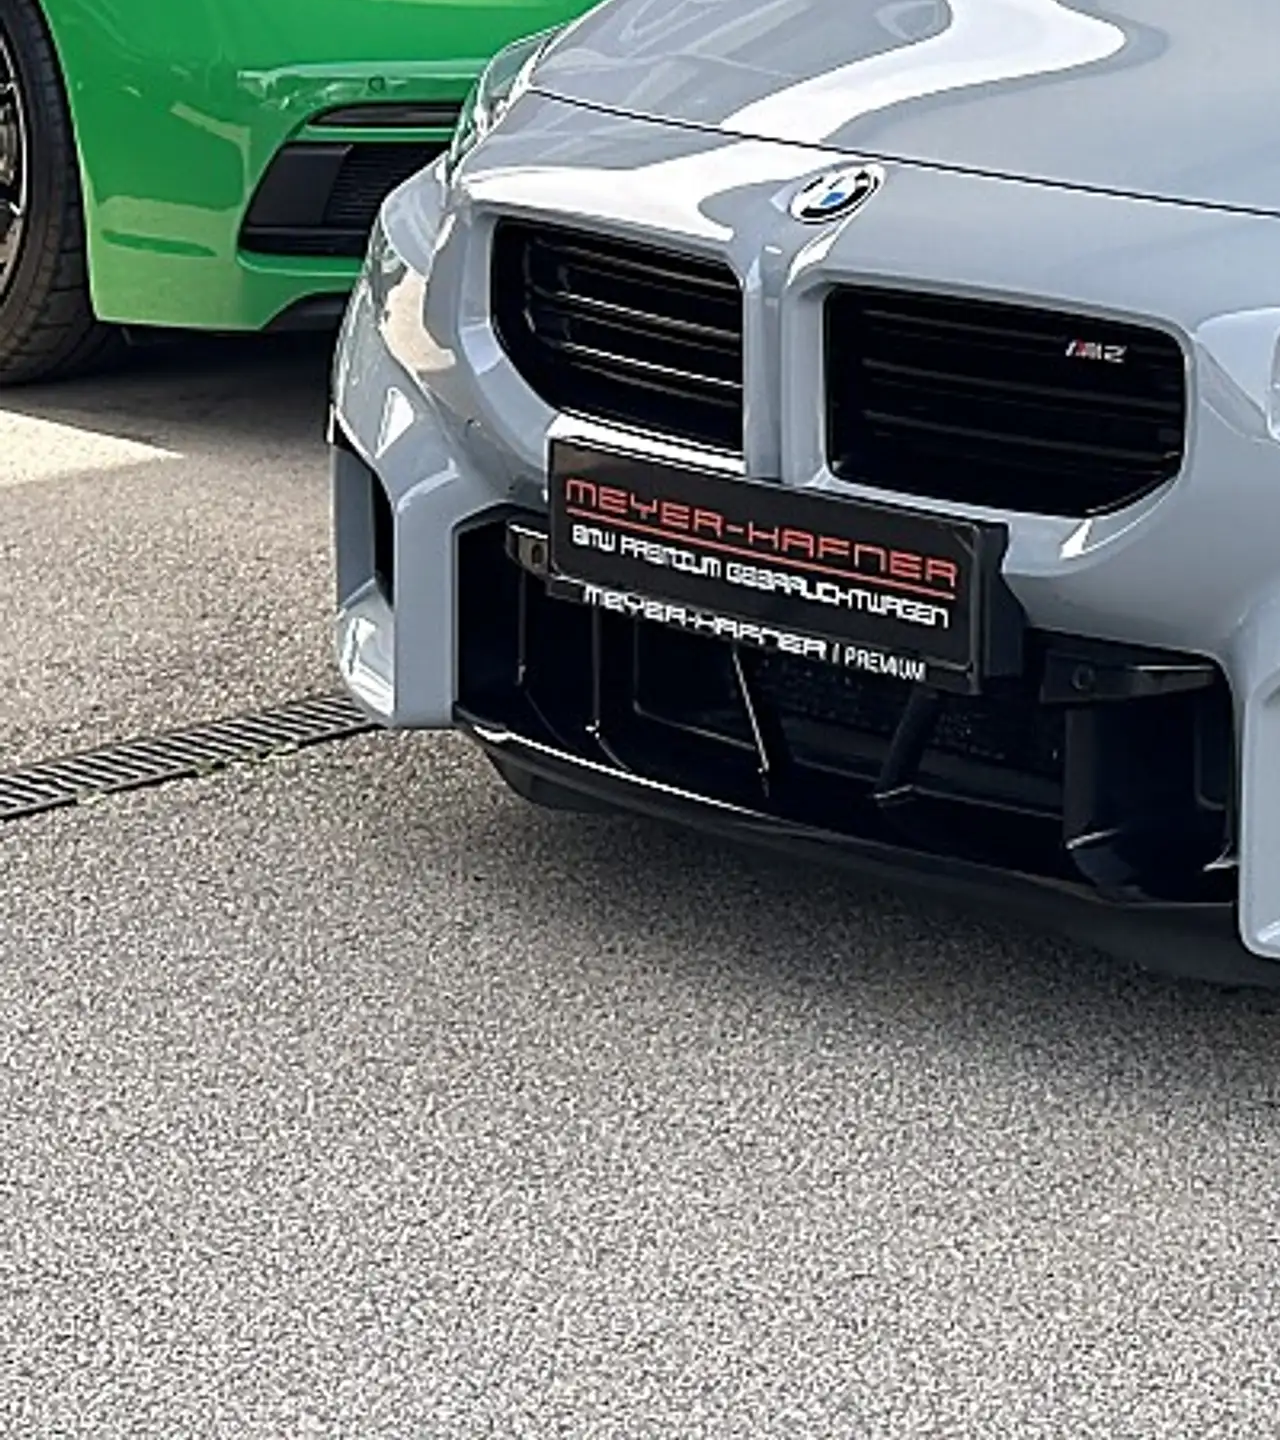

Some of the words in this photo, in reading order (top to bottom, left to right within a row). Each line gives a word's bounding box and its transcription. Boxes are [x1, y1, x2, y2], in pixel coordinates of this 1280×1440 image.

[565, 478, 957, 588] MEYER-HAFNER
[571, 523, 616, 552] BMW
[620, 534, 722, 579] PREMIUM
[725, 562, 950, 629] GEBRAUCHTWAGEN
